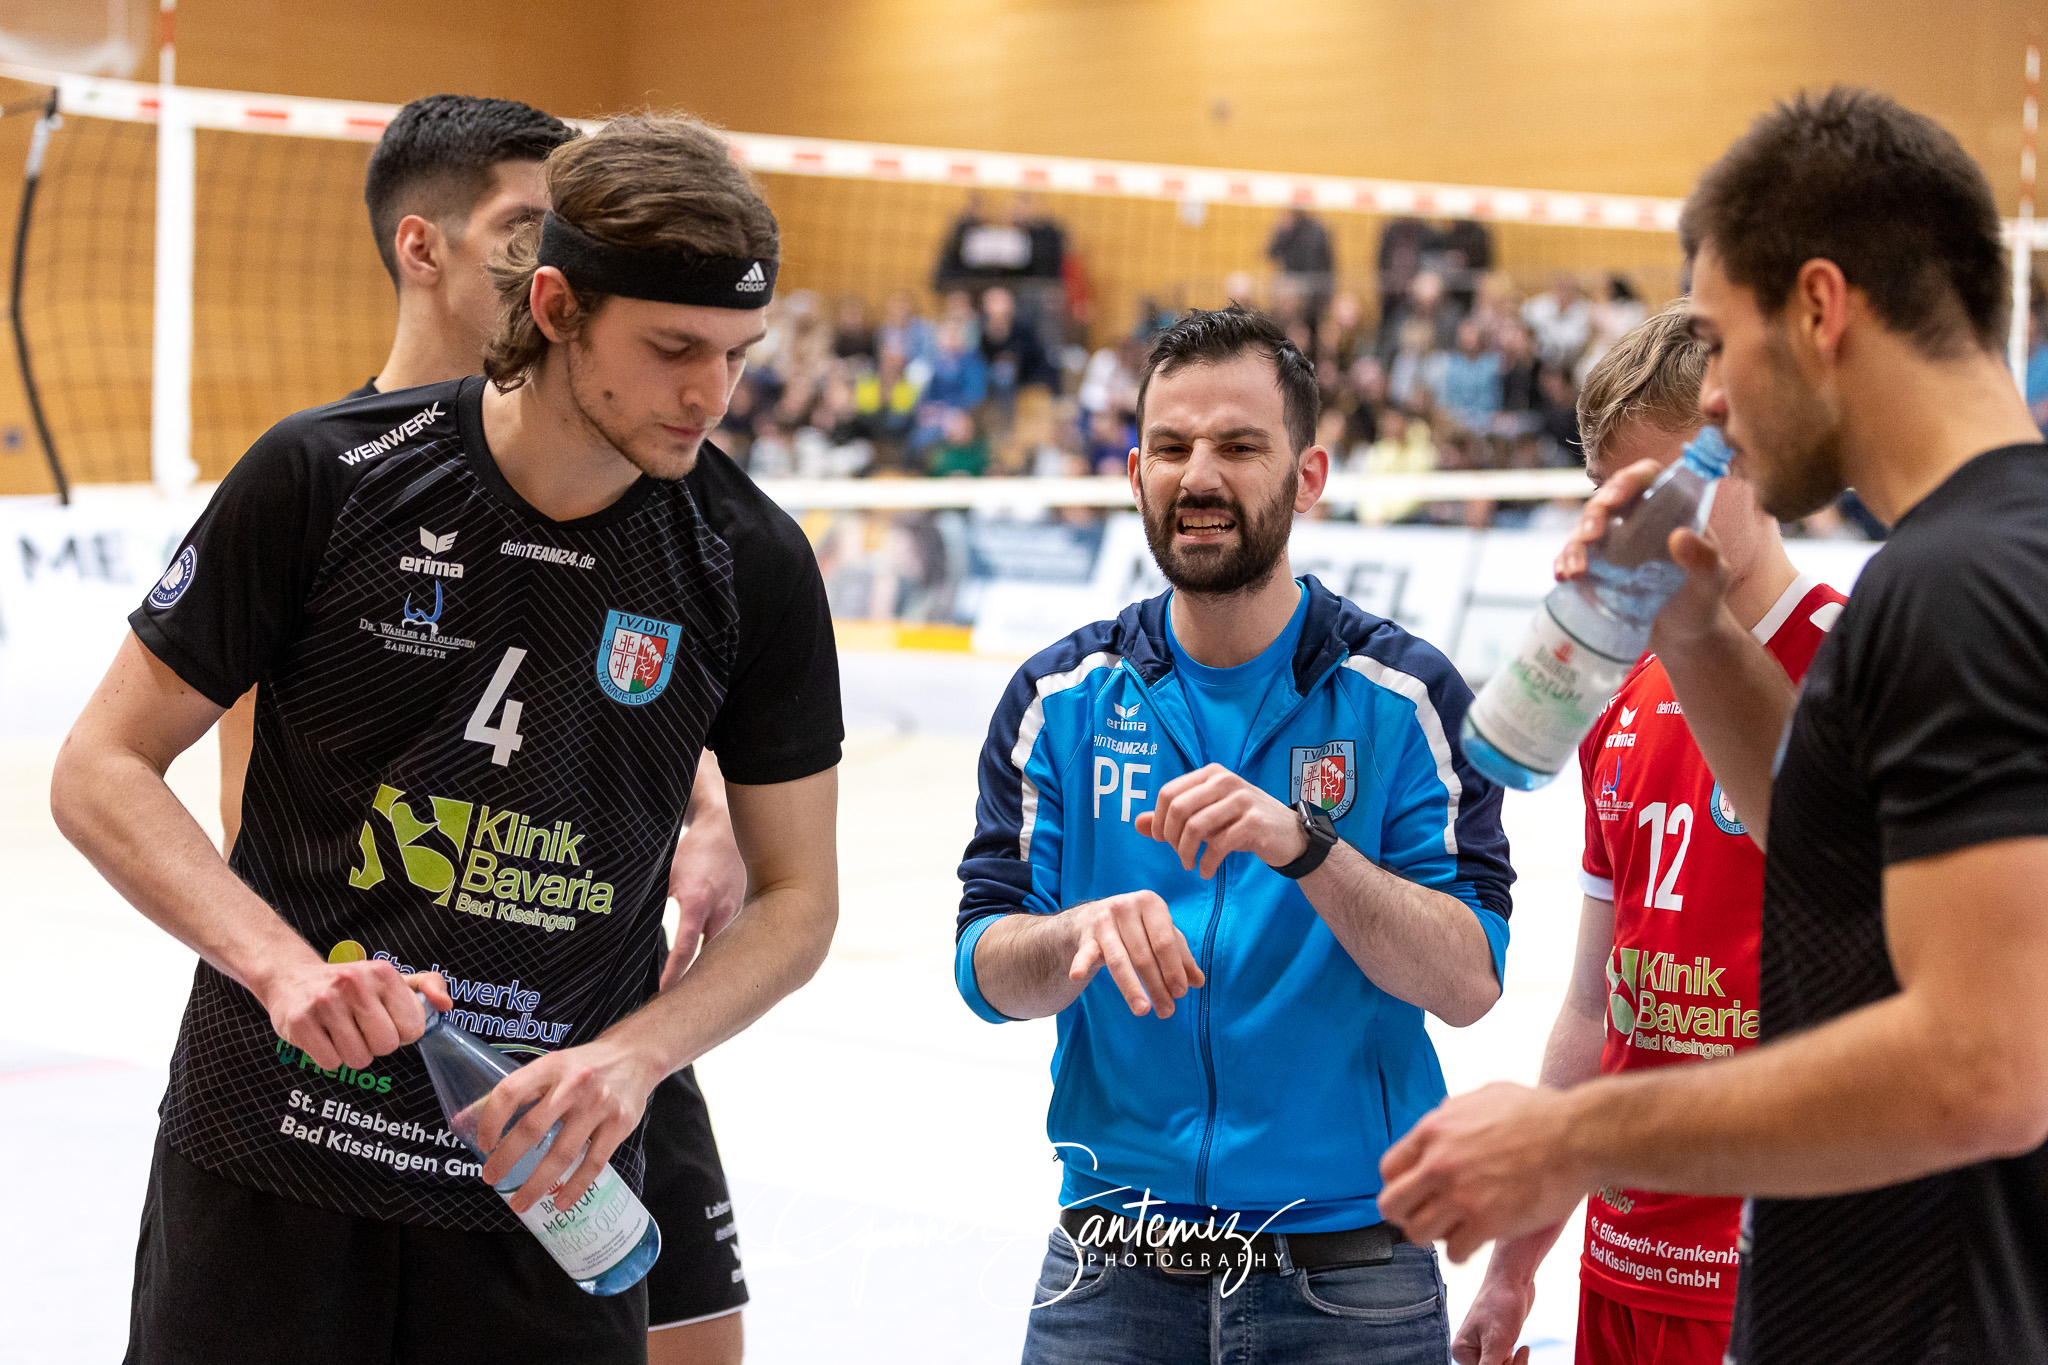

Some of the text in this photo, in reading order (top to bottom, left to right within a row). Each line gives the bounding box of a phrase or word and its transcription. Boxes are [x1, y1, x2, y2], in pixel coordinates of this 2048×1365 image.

[735, 279, 767, 292] adidas
[338, 401, 446, 466] WEINWERK
[400, 556, 464, 578] erima
[500, 539, 596, 569] deinTEAM24.de
[617, 613, 671, 636] TV/DJK
[384, 640, 447, 659] ZAHNÄRZTE
[602, 638, 611, 651] 18
[663, 652, 675, 664] 92
[598, 671, 663, 704] HAMMELBURG
[463, 646, 528, 767] 4
[1106, 718, 1147, 731] erima
[1605, 730, 1637, 749] erima
[1302, 743, 1344, 761] TV/DJK
[1093, 755, 1151, 822] PF
[473, 805, 586, 866] Klinik
[1638, 801, 1694, 912] 12
[461, 848, 615, 914] Bavaria
[455, 892, 576, 932] Bad Kissingen
[1640, 950, 1727, 997] Klinik
[1636, 990, 1760, 1039] Bavaria
[1635, 1031, 1734, 1059] Bad Kissingen
[288, 1089, 467, 1149] St. Elisabeth-Kr
[280, 1115, 324, 1144] Bad
[326, 1130, 438, 1173] Kissingen
[1591, 1216, 1600, 1236] St.
[1590, 1240, 1720, 1289] Bad Kissingen GmbH
